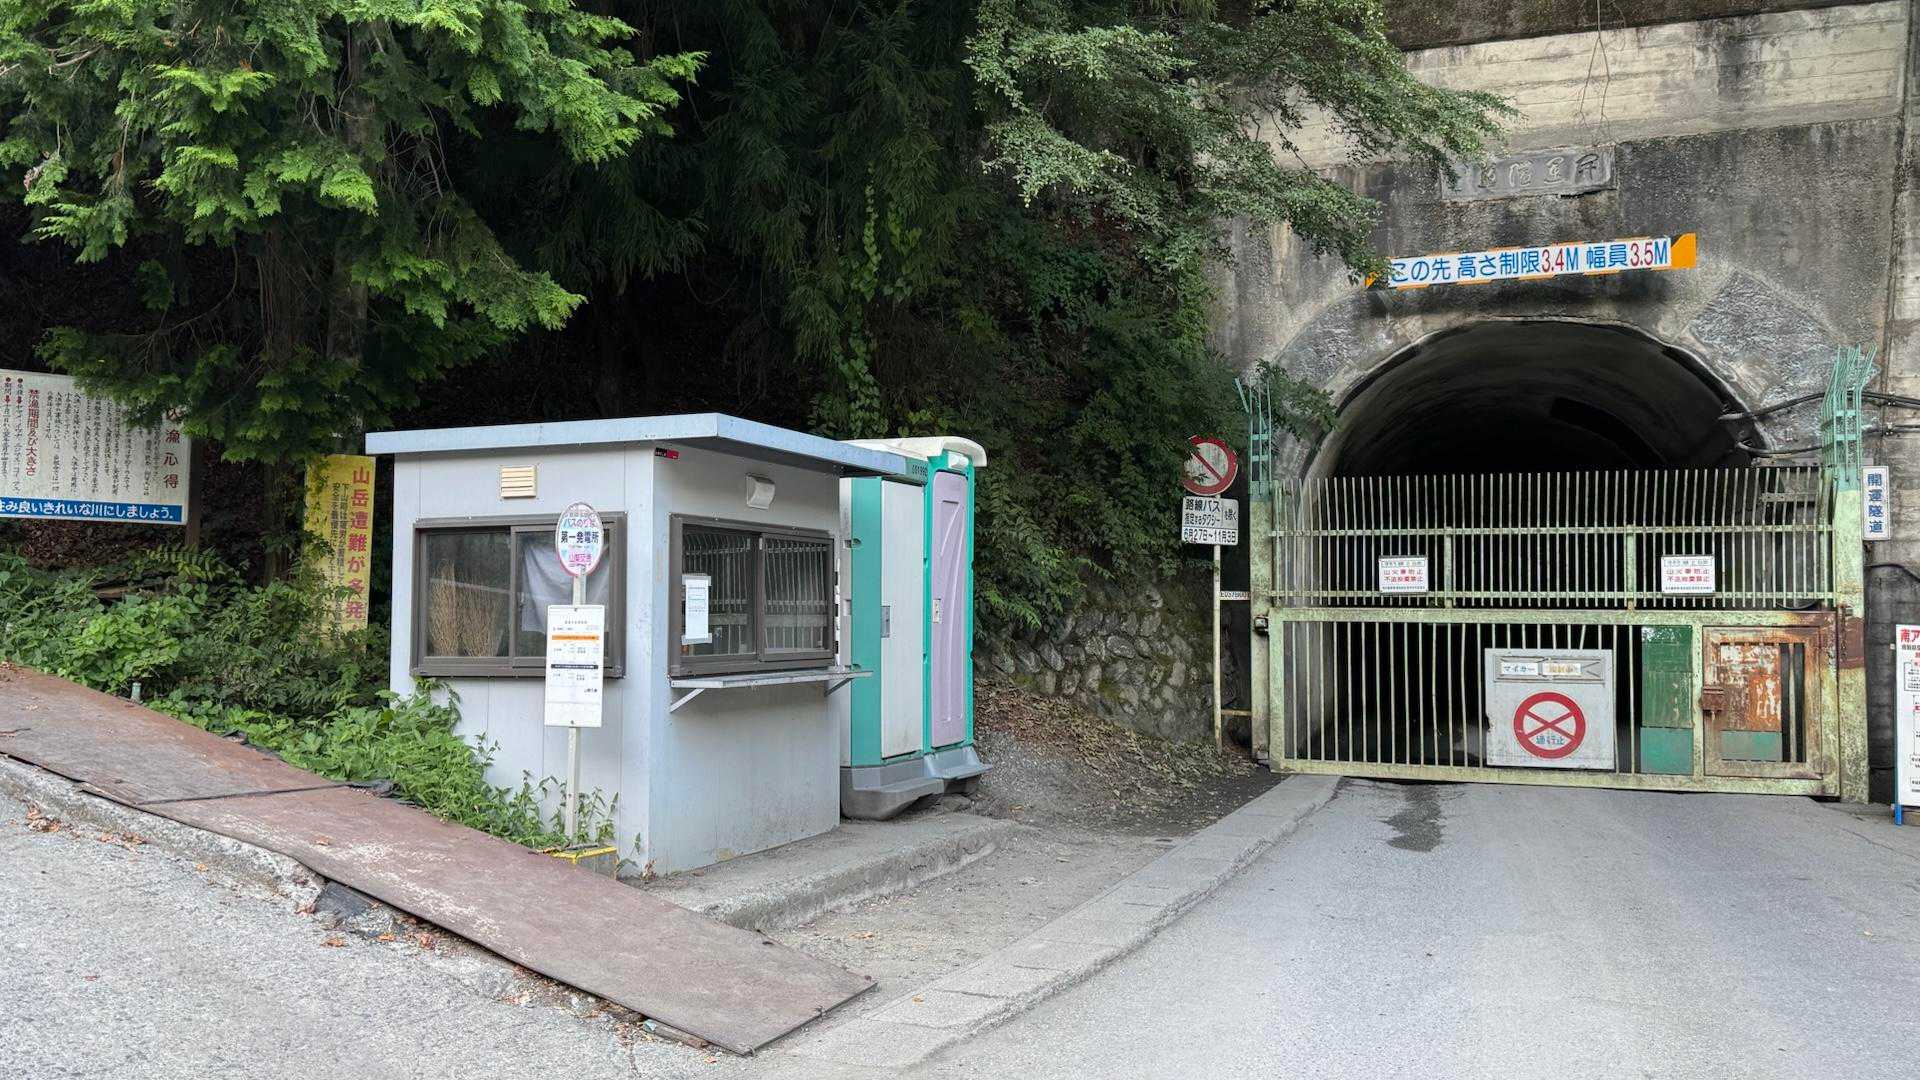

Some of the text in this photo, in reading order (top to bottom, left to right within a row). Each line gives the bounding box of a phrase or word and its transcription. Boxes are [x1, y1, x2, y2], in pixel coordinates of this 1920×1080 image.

[1390, 240, 1668, 284] この先 高さ制限3.4M 幅員3.5M
[26, 388, 39, 476] 禁漁期間及び大きさ
[1185, 498, 1221, 512] 路線バス
[1867, 473, 1884, 533] 開運隧道
[1224, 508, 1238, 521] を除く
[561, 530, 599, 544] 第一発電所
[1535, 735, 1566, 745] 通行止
